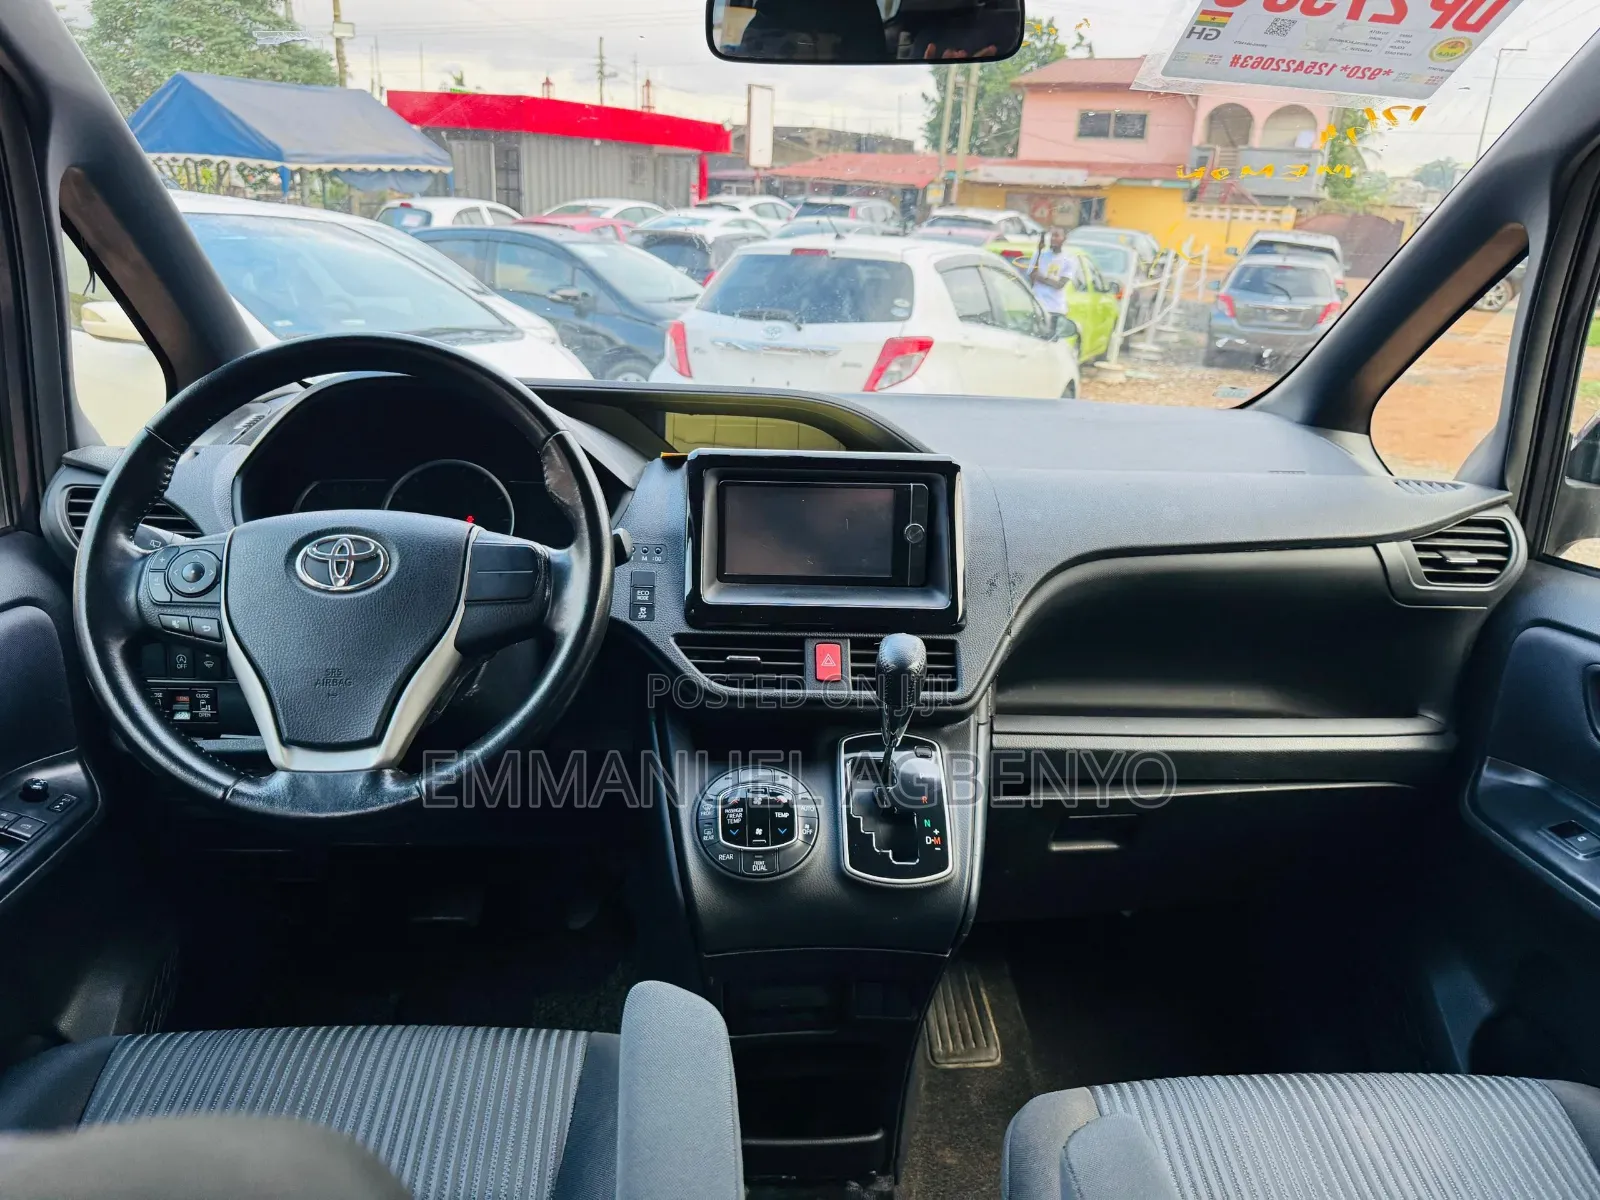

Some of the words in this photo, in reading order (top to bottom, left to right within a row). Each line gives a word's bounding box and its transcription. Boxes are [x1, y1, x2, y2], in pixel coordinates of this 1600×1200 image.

[315, 678, 353, 687] AIRBAG
[921, 796, 928, 804] R
[924, 819, 931, 828] N
[718, 853, 734, 861] REAR
